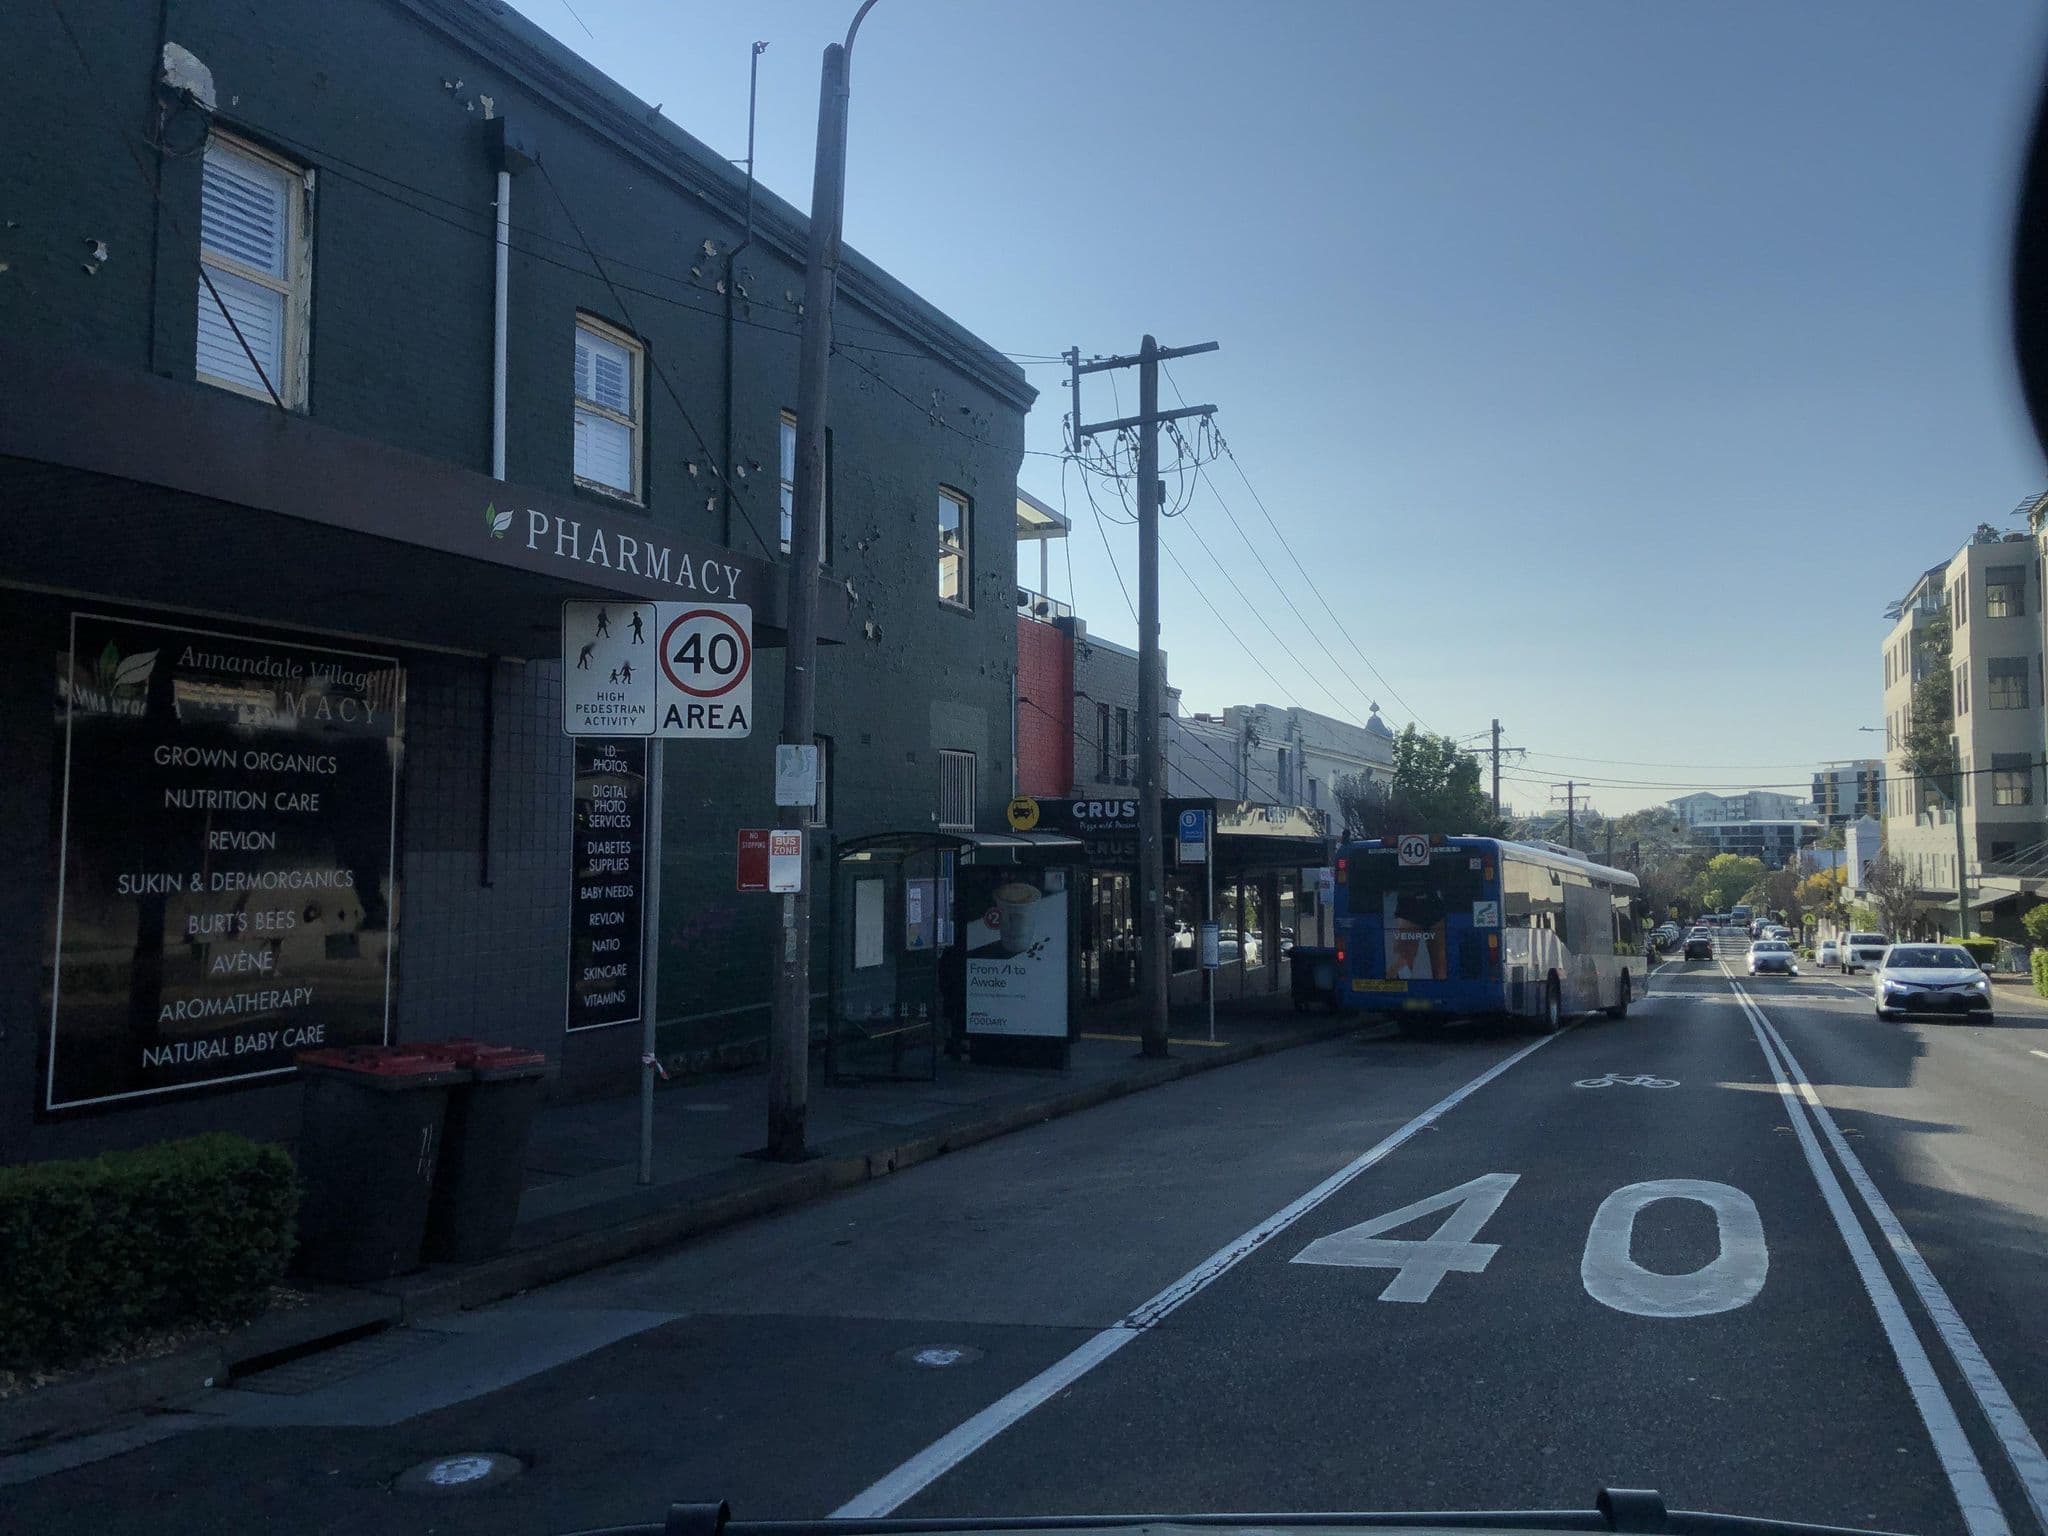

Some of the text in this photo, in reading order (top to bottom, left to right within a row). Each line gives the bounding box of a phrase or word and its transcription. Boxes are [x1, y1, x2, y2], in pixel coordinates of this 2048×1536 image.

[526, 508, 742, 600] PHARMACY
[673, 633, 739, 675] 40
[176, 645, 377, 692] Annandale Village
[597, 691, 625, 702] HIGH
[575, 703, 646, 714] PEDESTRIAN
[584, 716, 638, 726] ACTIVITY
[663, 703, 748, 730] AREA
[154, 744, 338, 775] GROWN ORGANICS
[593, 758, 628, 773] PHOTOS
[592, 784, 628, 798] DIGITAL
[164, 788, 321, 812] NUTRITION CARE
[594, 799, 626, 813] PHOTO
[1072, 801, 1140, 818] CRUS
[588, 814, 632, 828] SERVICES
[209, 831, 276, 850] REVLON
[749, 832, 759, 840] NO
[775, 836, 797, 845] BUS
[587, 841, 632, 855] DIABETES
[773, 846, 798, 855] ZONE
[1403, 842, 1425, 857] 40
[588, 858, 629, 872] SUPPLIES
[117, 870, 354, 895] SUKIN & DERMORGANICS
[580, 884, 634, 900] BABY NEEDS
[188, 911, 296, 934] BURT'S BEES
[589, 911, 625, 926] REVLON
[1393, 932, 1437, 941] VENROY
[592, 938, 621, 953] NATIO
[583, 963, 628, 981] SKINCARE
[970, 963, 998, 975] From
[1014, 965, 1026, 975] to
[970, 976, 1007, 988] Awake
[158, 987, 314, 1023] AROMATHERAPY
[584, 990, 626, 1007] VITAMINS
[142, 1024, 326, 1069] NATURAL BABY CARE
[1289, 1172, 1769, 1317] 40
